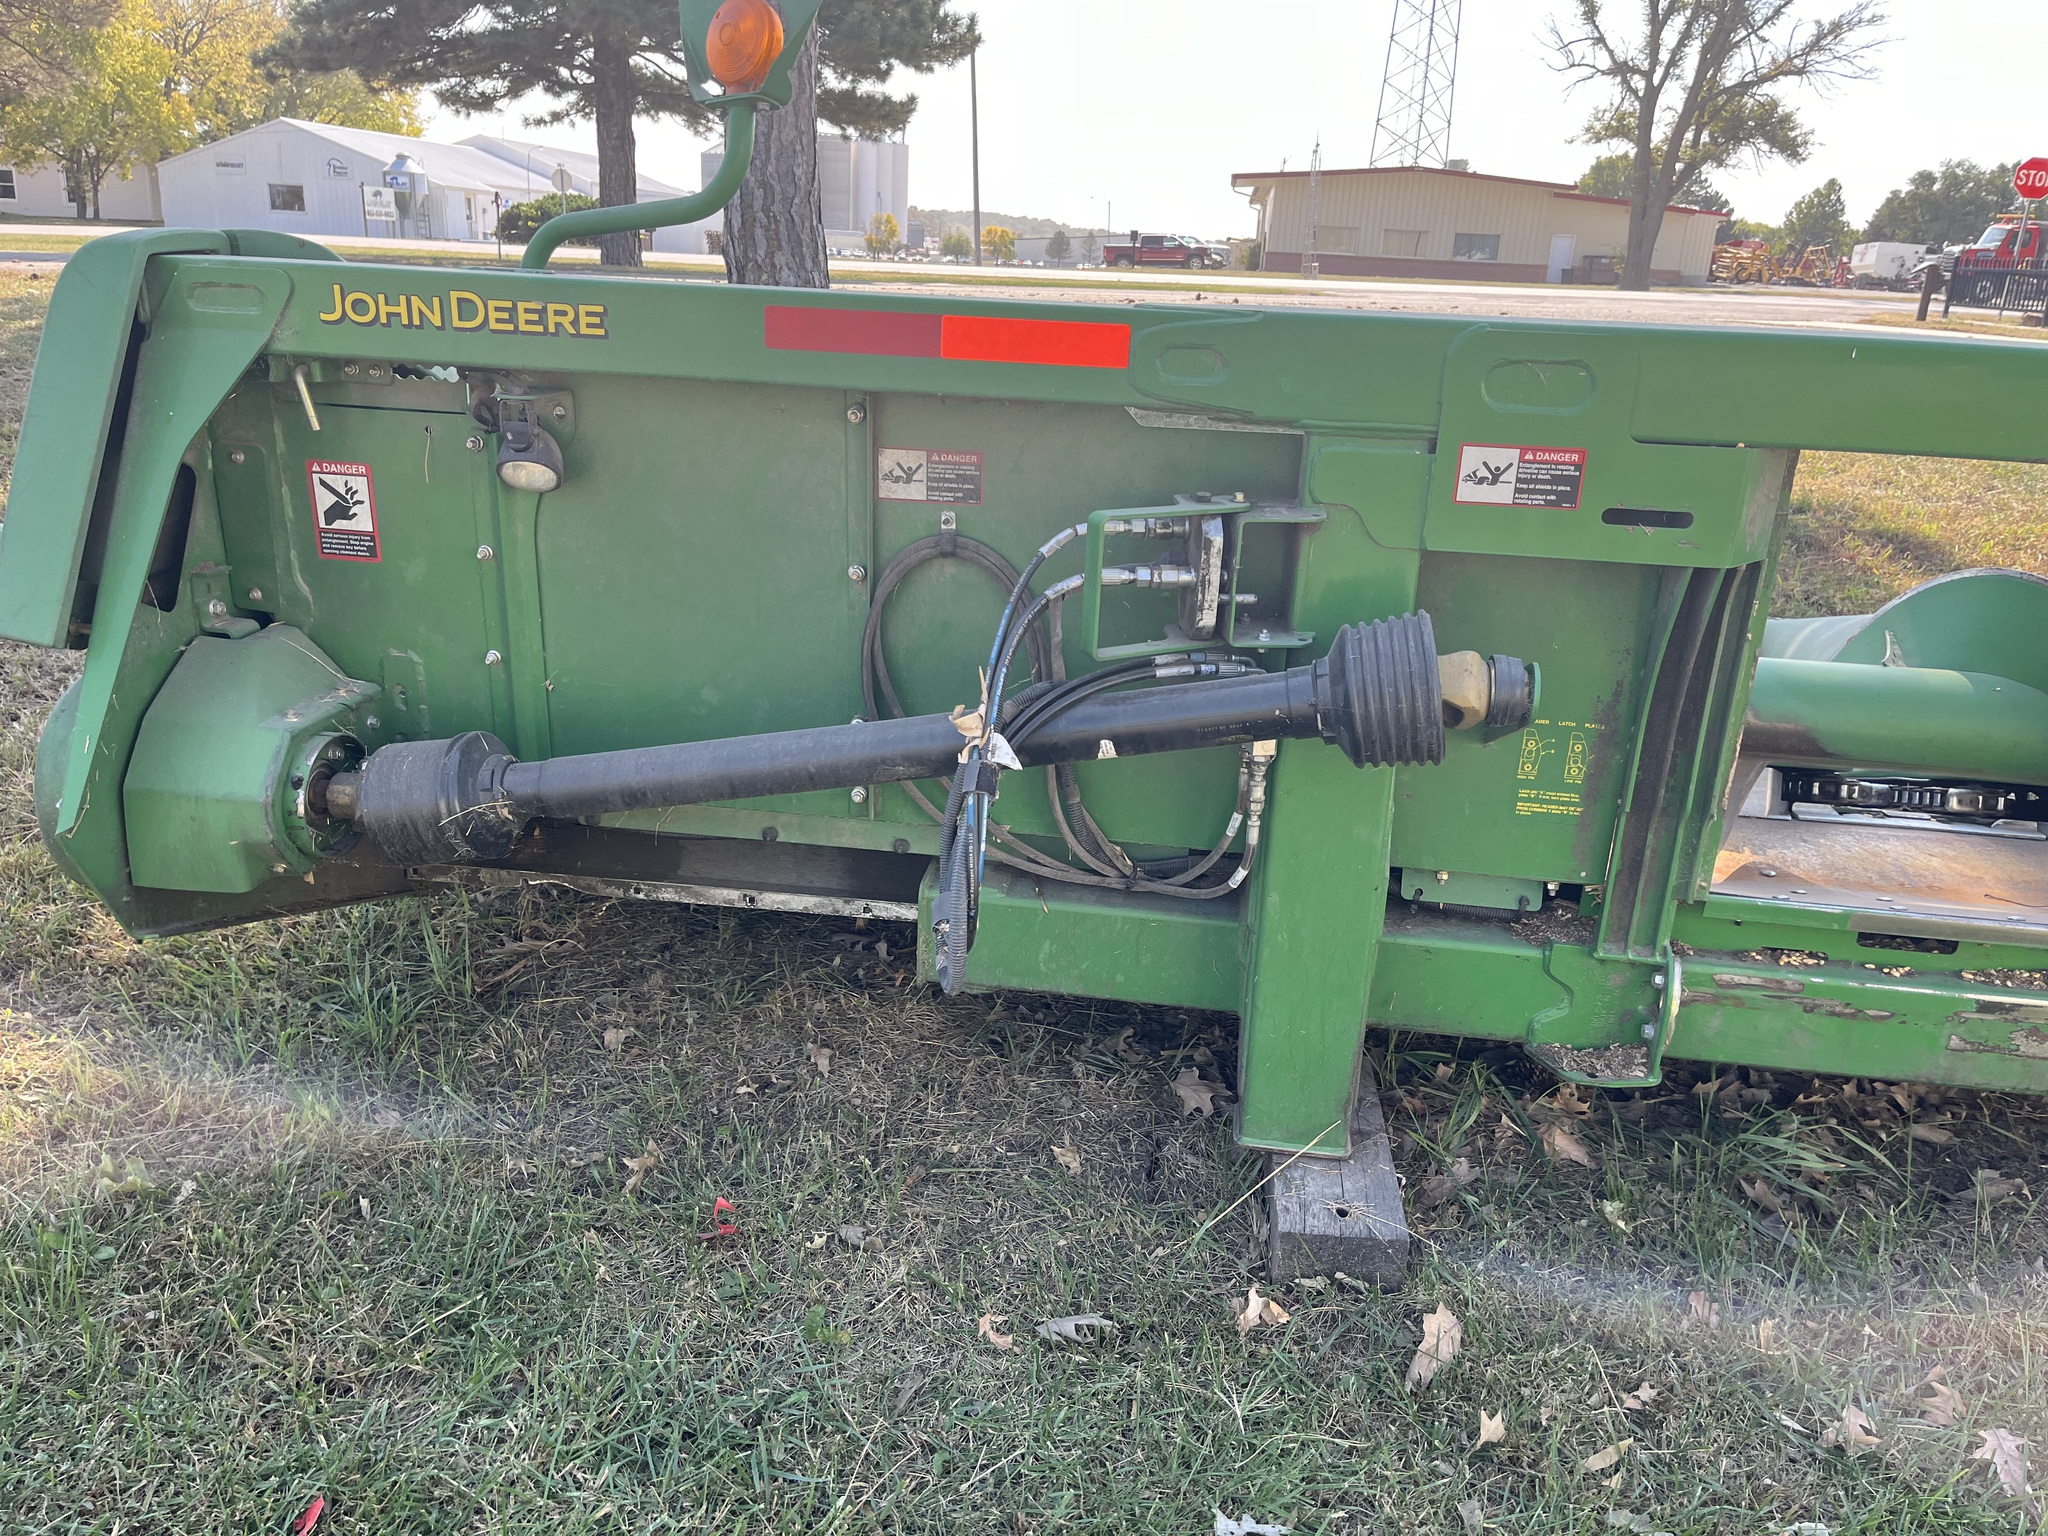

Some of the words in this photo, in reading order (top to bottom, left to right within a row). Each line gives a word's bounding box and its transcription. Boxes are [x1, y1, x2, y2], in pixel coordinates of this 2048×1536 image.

[2017, 169, 2048, 188] STO
[320, 282, 445, 330] JOHN
[449, 289, 608, 339] DEERE
[1536, 452, 1578, 462] DANGER
[322, 463, 366, 474] DANGER
